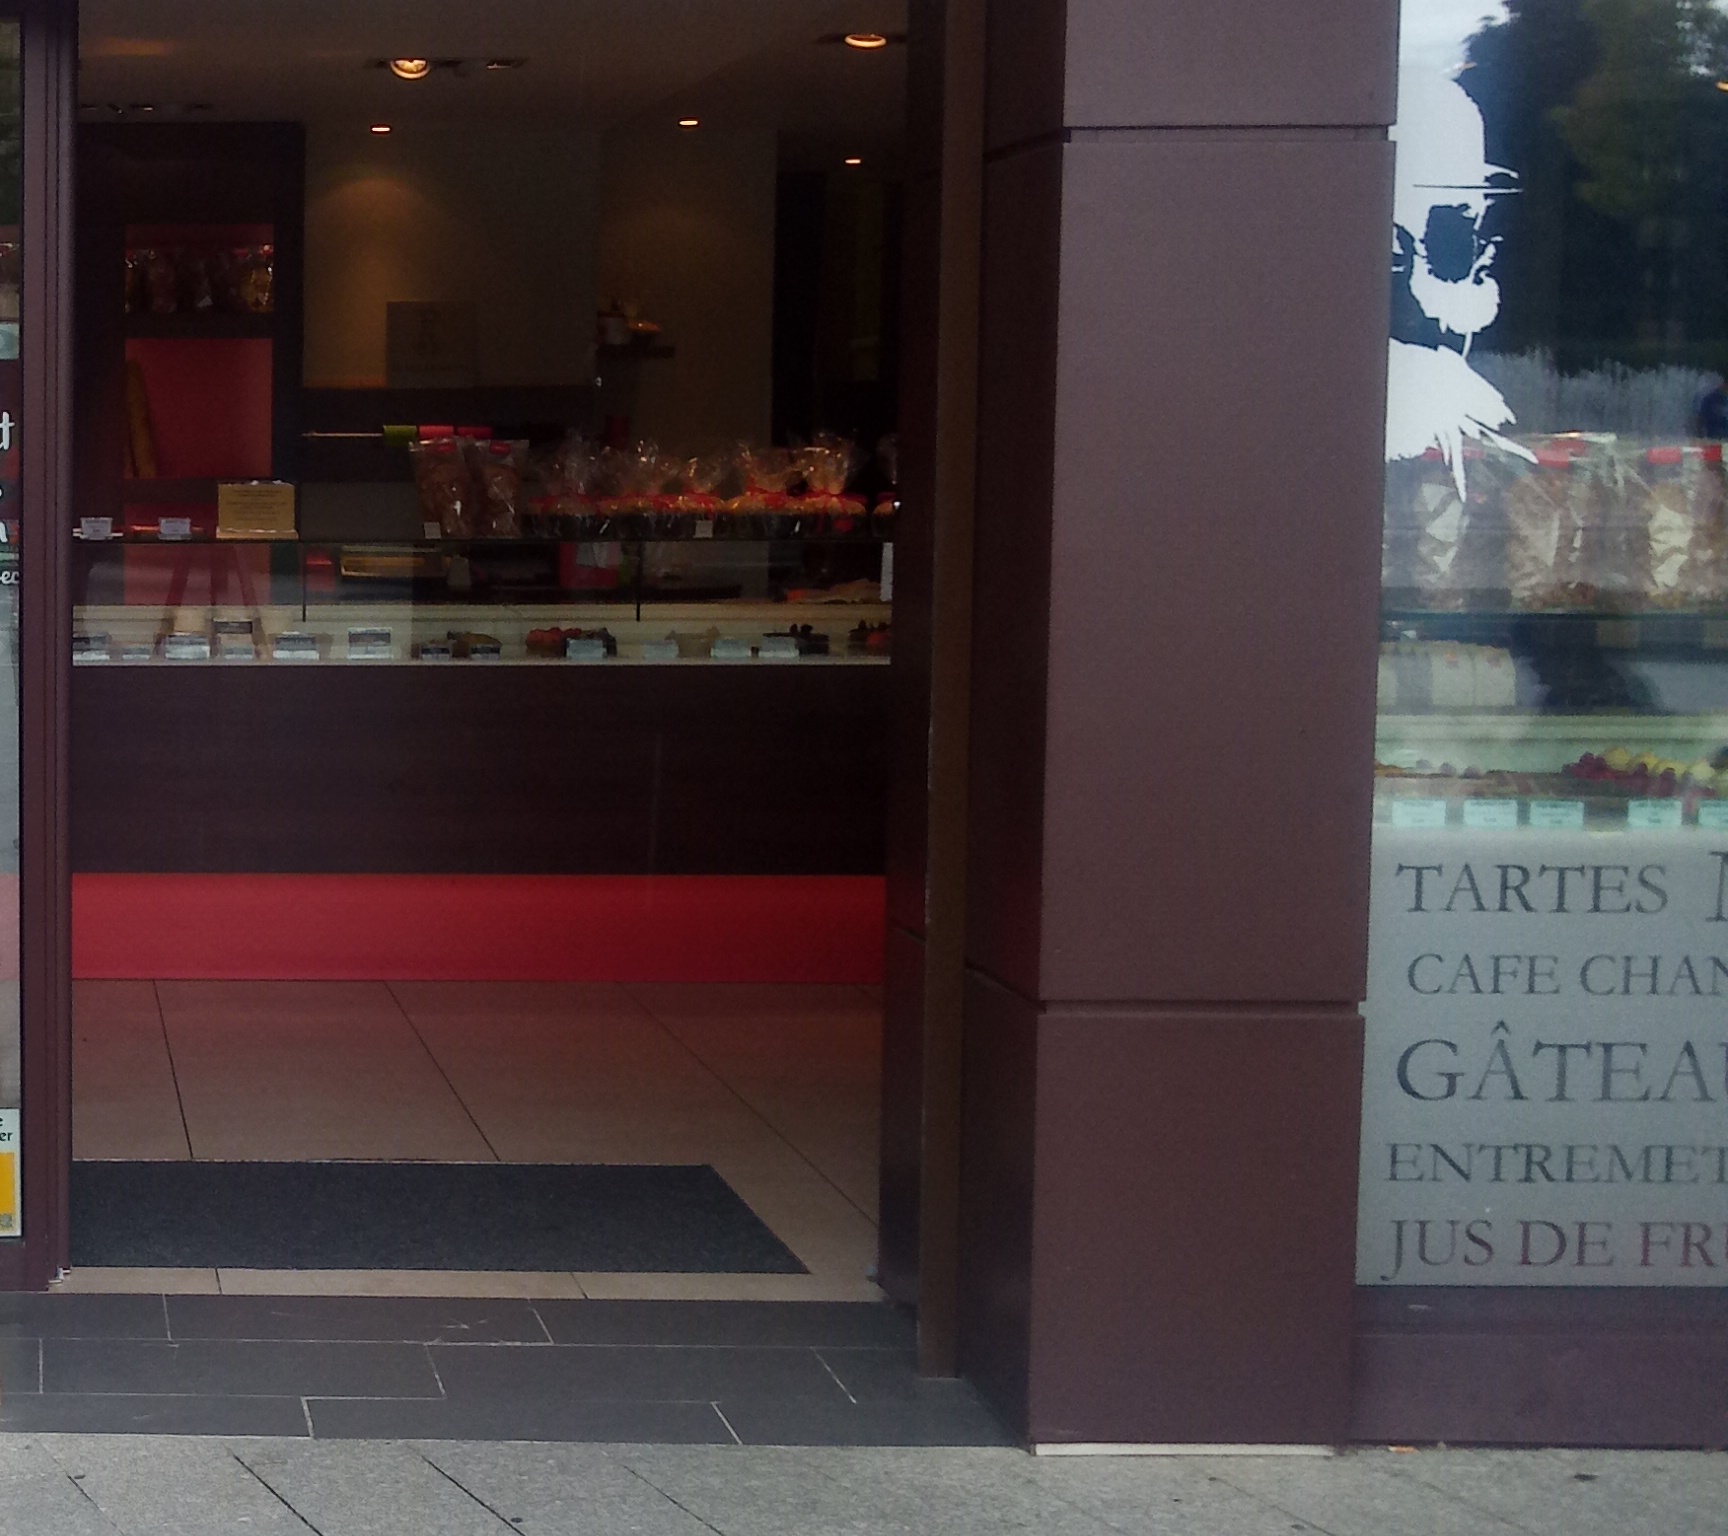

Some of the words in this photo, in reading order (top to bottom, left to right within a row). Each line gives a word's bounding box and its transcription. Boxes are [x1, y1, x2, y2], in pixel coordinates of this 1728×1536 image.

[1396, 864, 1669, 914] TARTES
[1407, 953, 1560, 996] CAFE
[1396, 1021, 1728, 1102] GÂTEA
[1380, 1219, 1495, 1281] JUS
[1519, 1219, 1613, 1267] DE
[1638, 1220, 1728, 1267] FR
